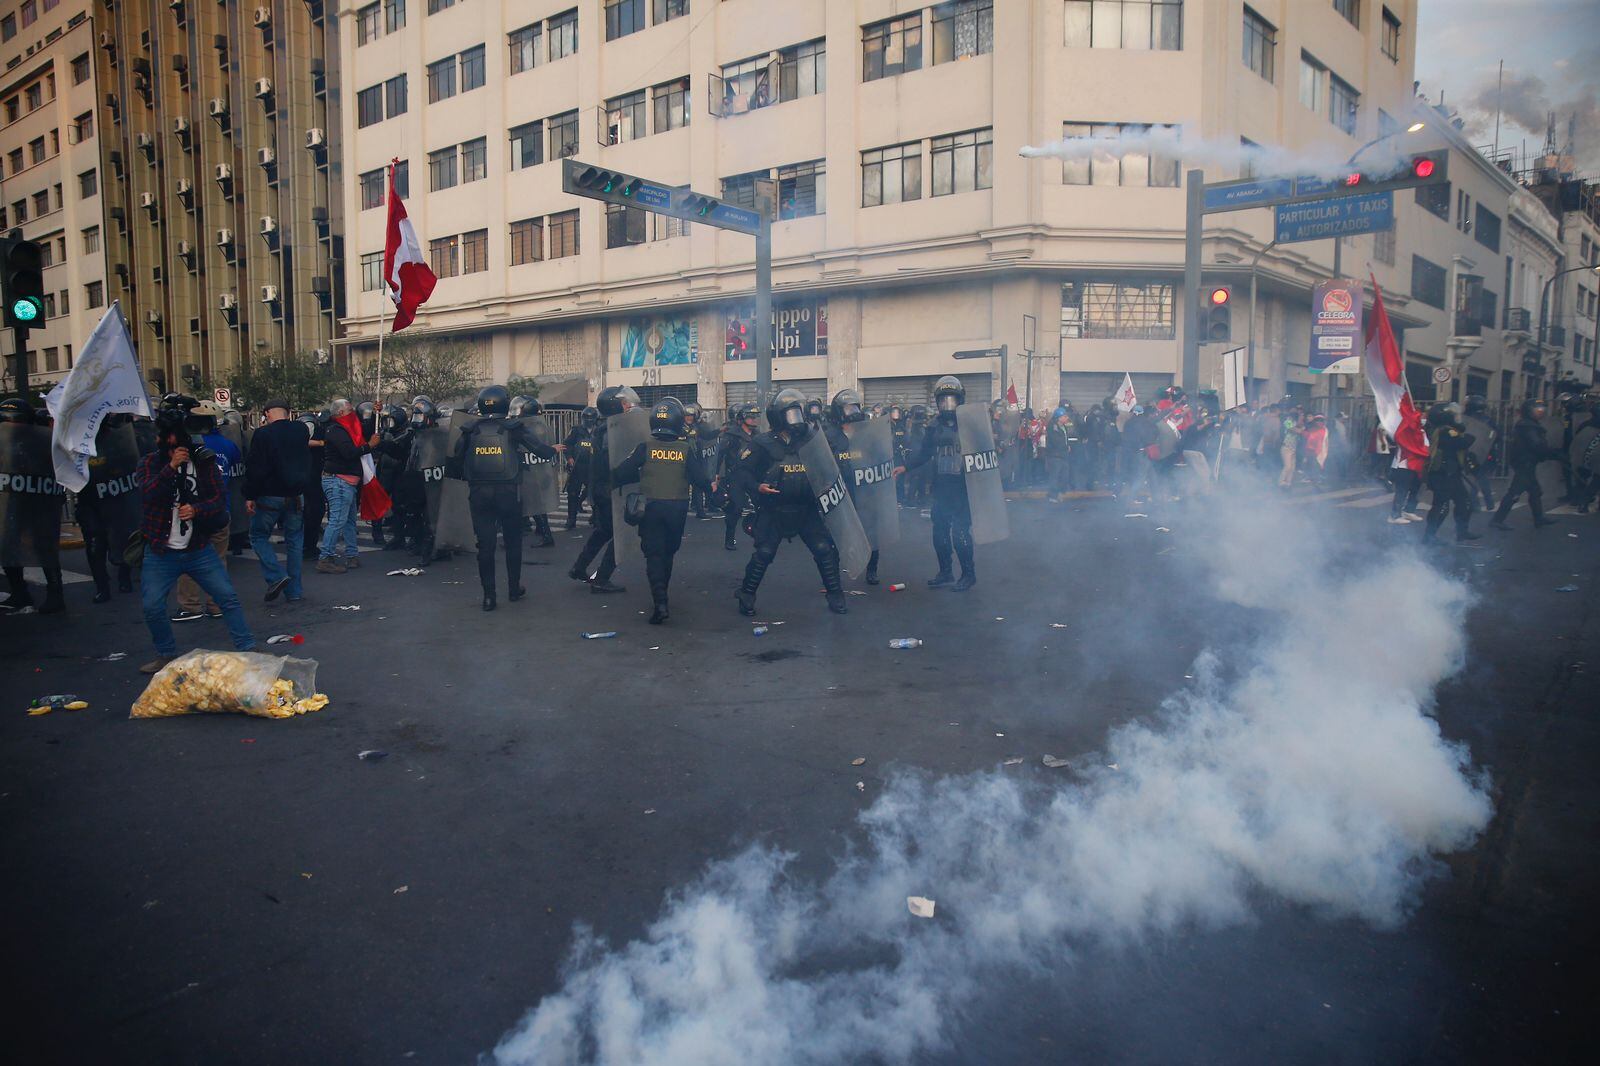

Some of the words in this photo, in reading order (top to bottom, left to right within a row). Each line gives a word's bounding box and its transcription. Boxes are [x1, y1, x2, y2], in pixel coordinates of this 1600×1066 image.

[1279, 205, 1339, 224] PARTICULAR
[1346, 203, 1352, 215] Y
[1359, 199, 1388, 213] TAXIS
[1297, 217, 1370, 237] AUTORIZADOS
[770, 307, 810, 329] ippo
[1318, 311, 1355, 319] CELEBRA
[642, 368, 661, 386] 291
[475, 446, 502, 455] POLICIA
[651, 449, 683, 461] POLICIA
[779, 464, 806, 473] OLICIA
[819, 473, 846, 513] POLI
